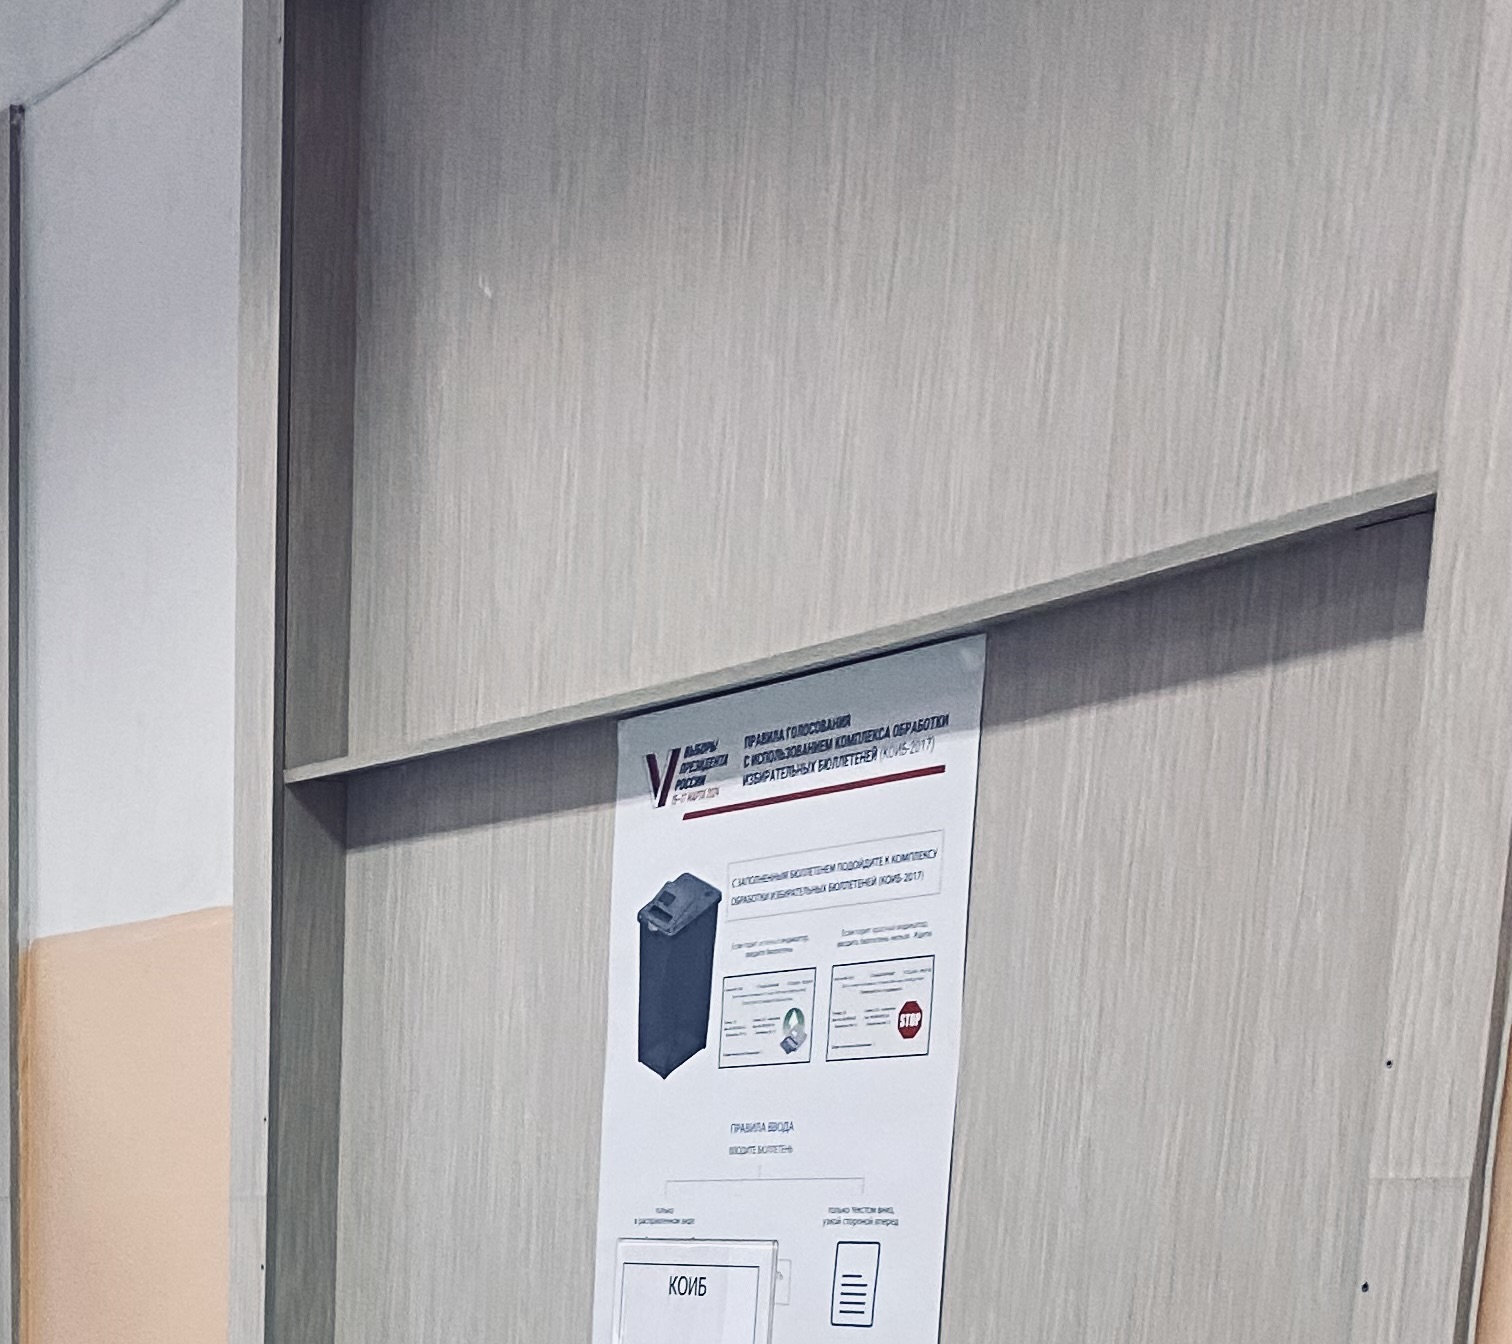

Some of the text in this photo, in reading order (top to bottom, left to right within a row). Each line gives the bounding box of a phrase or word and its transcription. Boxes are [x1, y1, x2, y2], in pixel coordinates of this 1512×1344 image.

[835, 725, 890, 749] КОМПЛЕКСА
[893, 712, 950, 737] ОБРАБОТКИ
[743, 761, 815, 786] ИЗБИРАТЕЛЬНЫХ
[818, 746, 878, 772] БЮЛЛЕТЕНЕЙ
[899, 1012, 922, 1029] STOP
[668, 1275, 707, 1297] КОИБ
